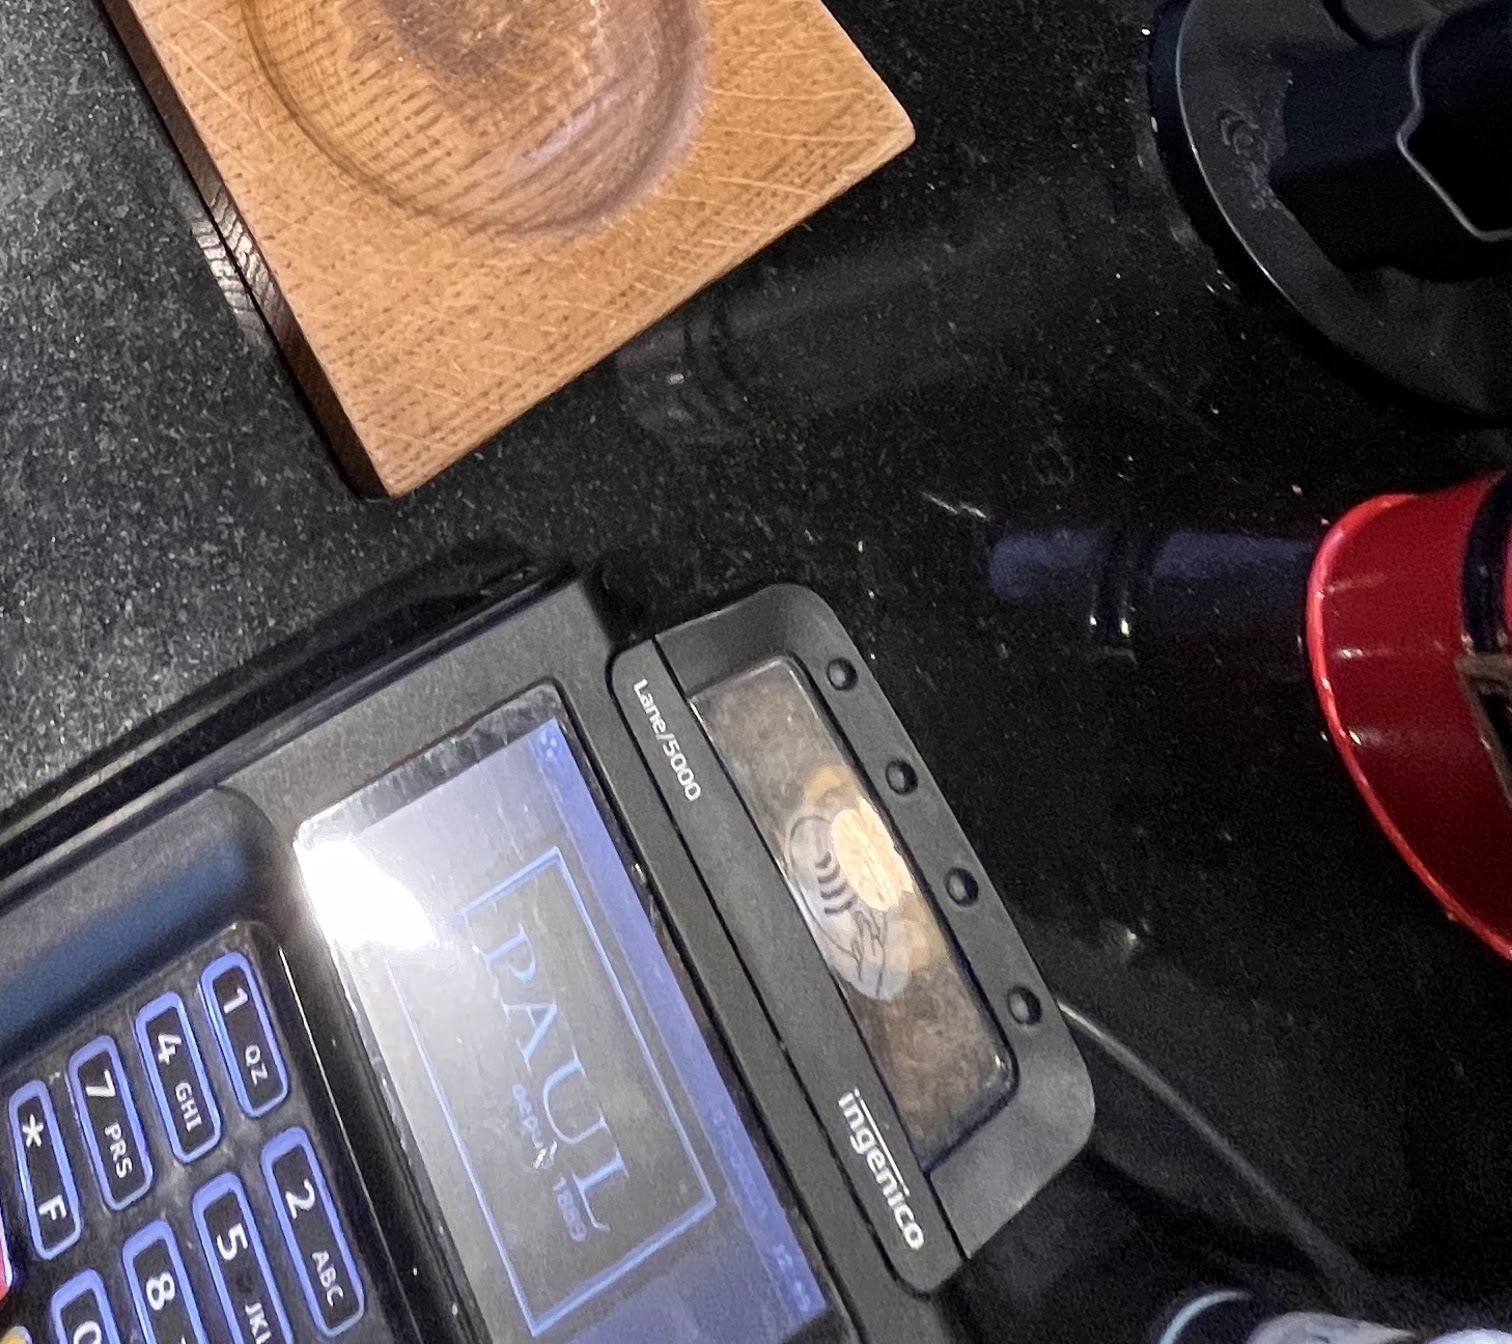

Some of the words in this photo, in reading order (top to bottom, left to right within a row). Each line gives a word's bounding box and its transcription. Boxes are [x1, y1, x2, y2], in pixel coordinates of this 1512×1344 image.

[633, 678, 702, 802] Lane/5000
[221, 986, 250, 1014] 1
[155, 1032, 183, 1066] 4
[244, 1044, 270, 1086] QZ
[85, 1069, 116, 1100] 7
[480, 922, 631, 1232] PAUL
[173, 1081, 203, 1132] GHI
[104, 1122, 134, 1179] PRS
[838, 1086, 925, 1250] ingenico
[38, 1194, 68, 1221] F
[284, 1178, 316, 1219] 2
[216, 1222, 249, 1261] 5
[145, 1271, 176, 1311] 8
[311, 1250, 345, 1307] ABC
